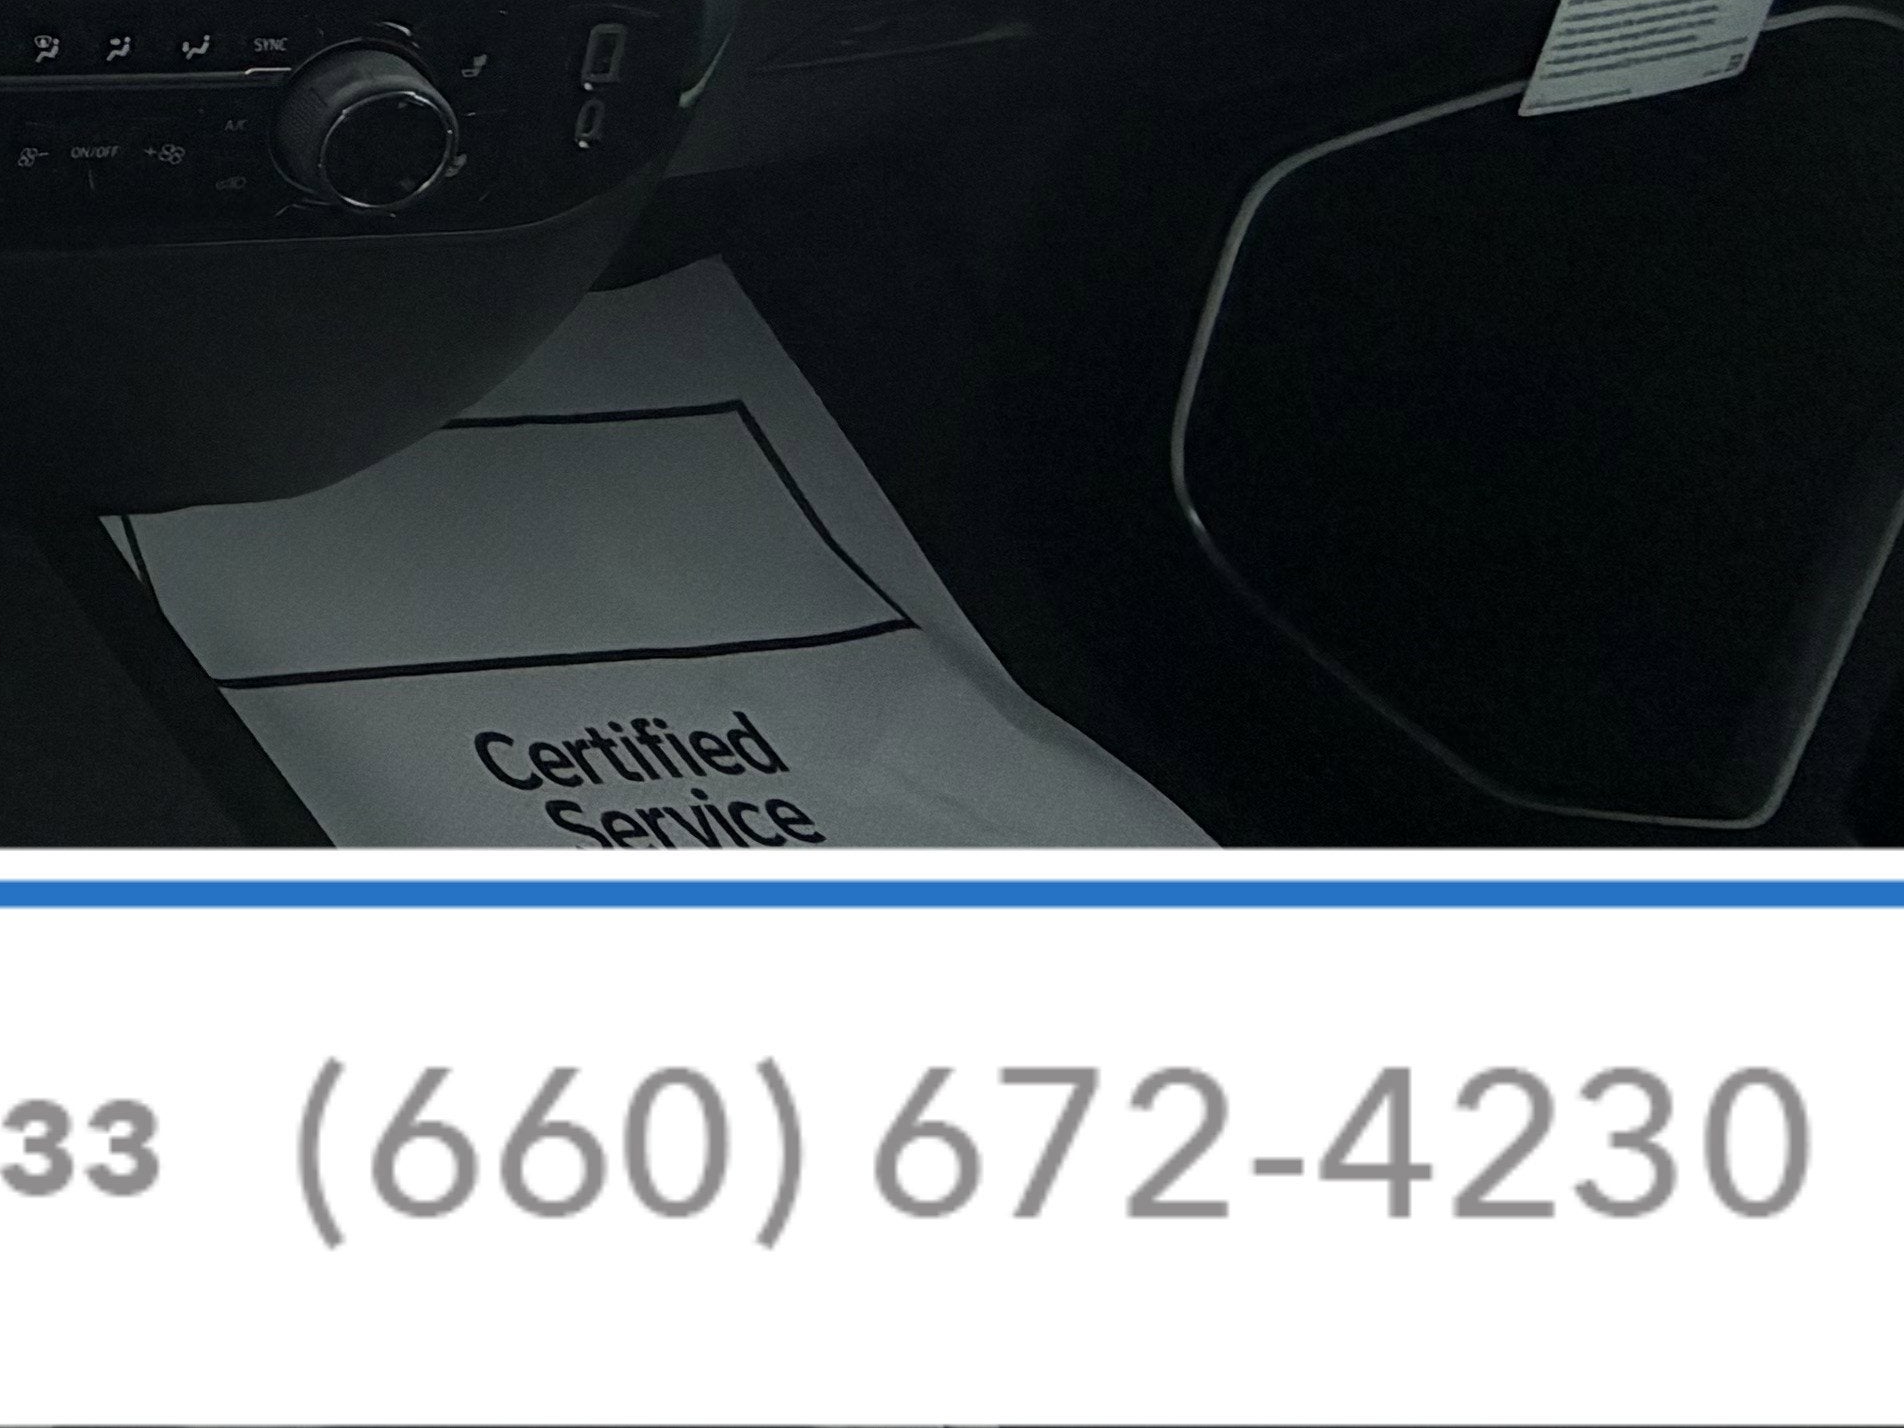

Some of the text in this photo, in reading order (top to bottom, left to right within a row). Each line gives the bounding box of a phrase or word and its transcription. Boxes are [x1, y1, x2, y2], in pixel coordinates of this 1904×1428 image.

[253, 37, 289, 53] SYNC
[69, 145, 120, 160] ON/OFF
[473, 710, 791, 792] Certified
[544, 787, 828, 850] Service
